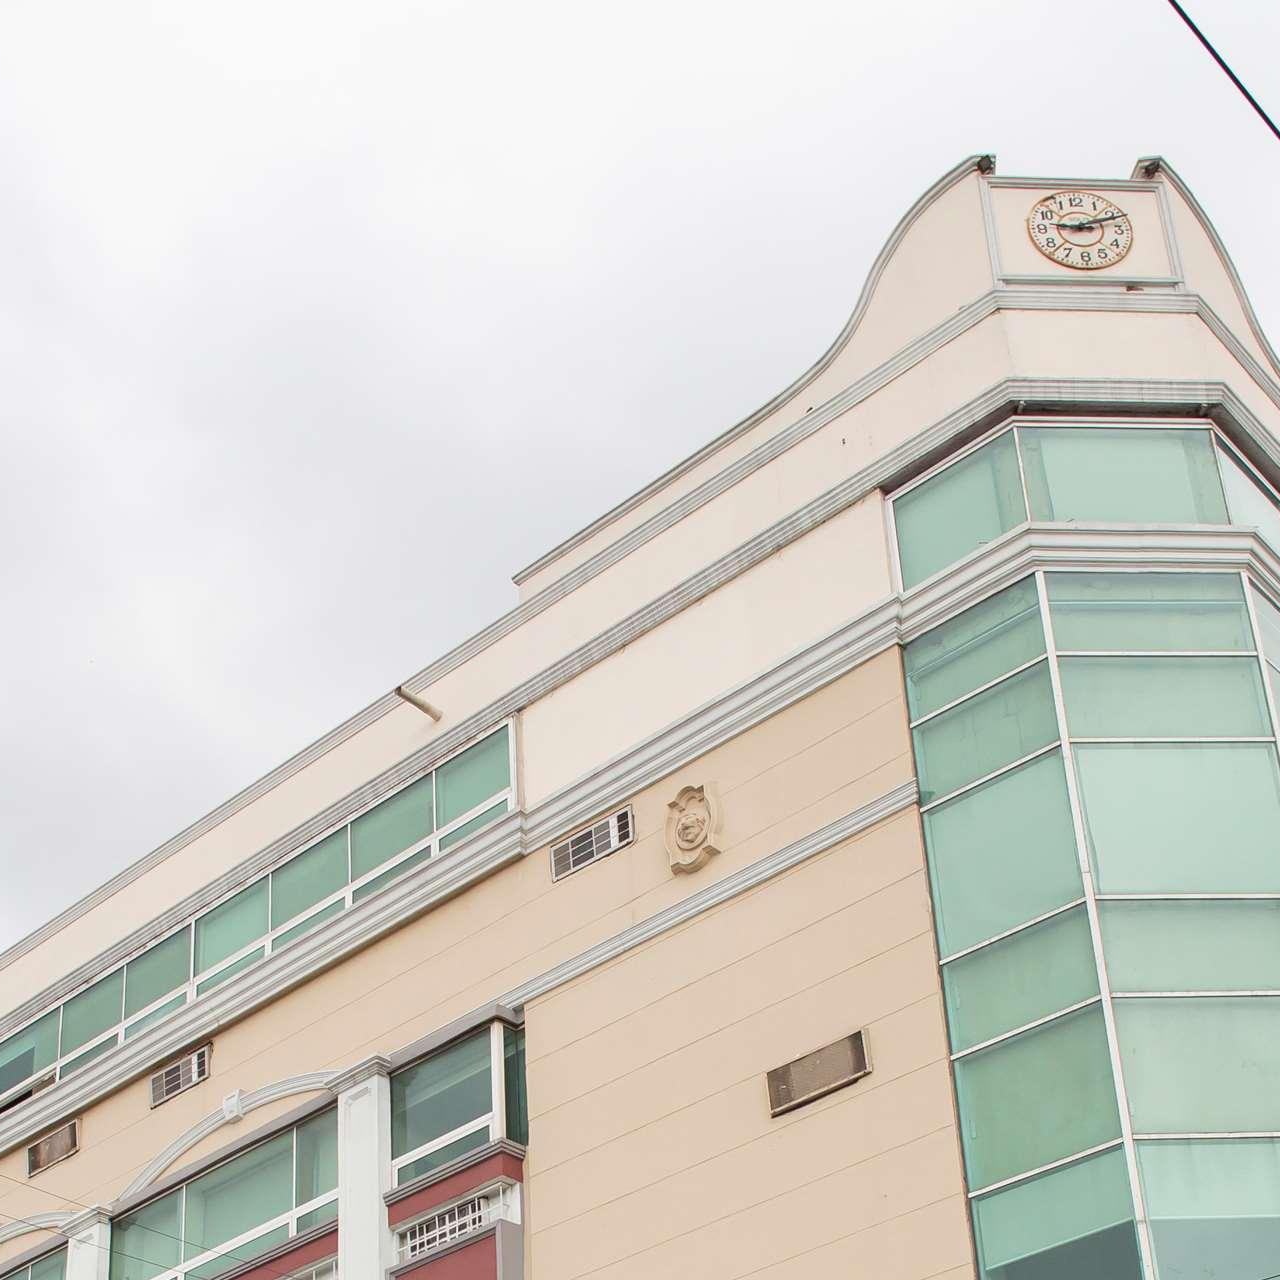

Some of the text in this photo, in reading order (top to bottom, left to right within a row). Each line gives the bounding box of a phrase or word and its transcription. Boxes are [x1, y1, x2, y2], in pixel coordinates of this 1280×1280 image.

[1069, 197, 1083, 208] 12
[1041, 210, 1054, 221] 10
[1114, 224, 1124, 236] 3
[1064, 248, 1072, 259] 7
[1098, 248, 1108, 260] 5
